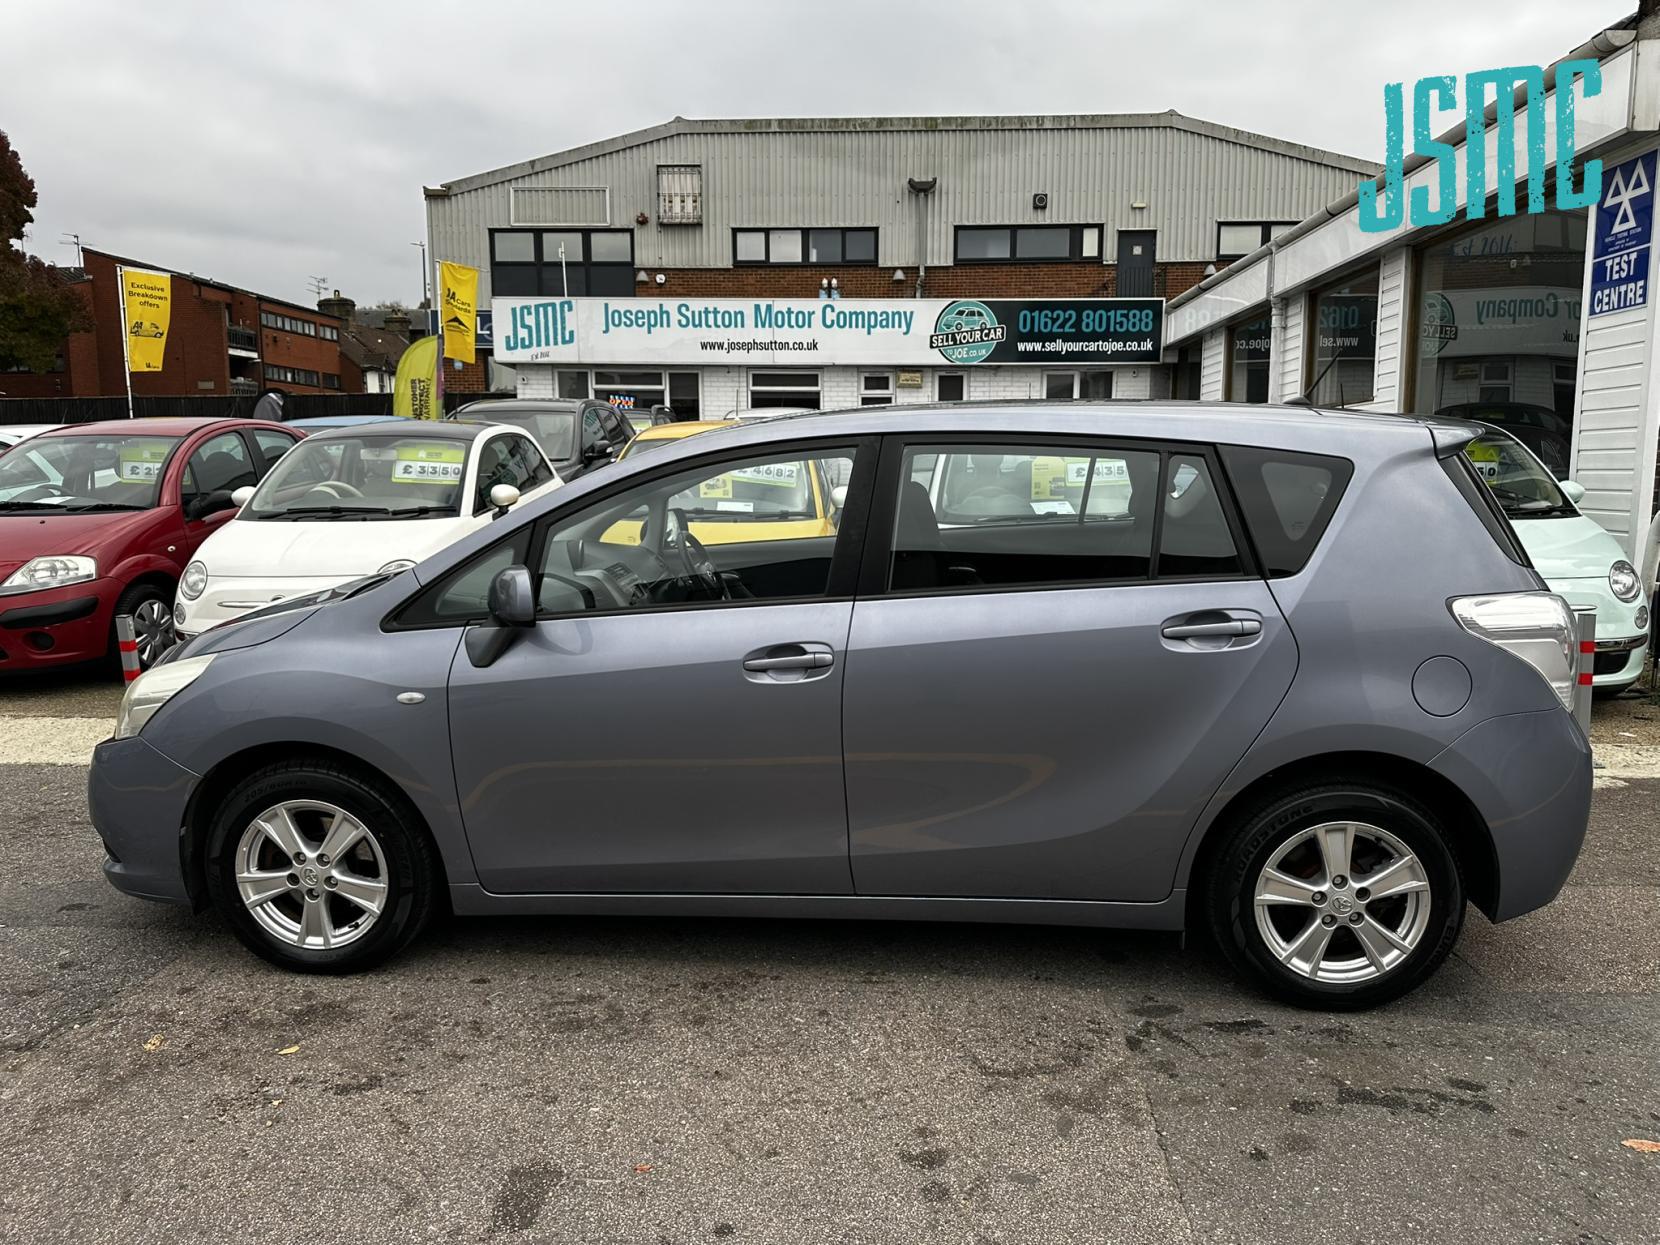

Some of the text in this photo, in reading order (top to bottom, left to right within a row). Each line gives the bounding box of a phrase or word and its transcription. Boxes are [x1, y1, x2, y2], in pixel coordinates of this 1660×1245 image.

[1605, 252, 1637, 281] TEST
[128, 290, 168, 301] Breakdown
[131, 282, 165, 292] Exclusive
[1594, 280, 1644, 313] CENTRE
[139, 300, 160, 309] offers
[505, 300, 575, 351] JSMC
[603, 303, 914, 335] Joseph Sutton Motor Company
[1018, 309, 1153, 333] 01622 801588
[700, 338, 819, 354] www.josephsutton.co.uk
[932, 328, 1002, 347] SELL YOUR CAR
[1017, 338, 1153, 355] www.sellyourcartojoe.co.uk
[410, 378, 418, 418] USTOMER
